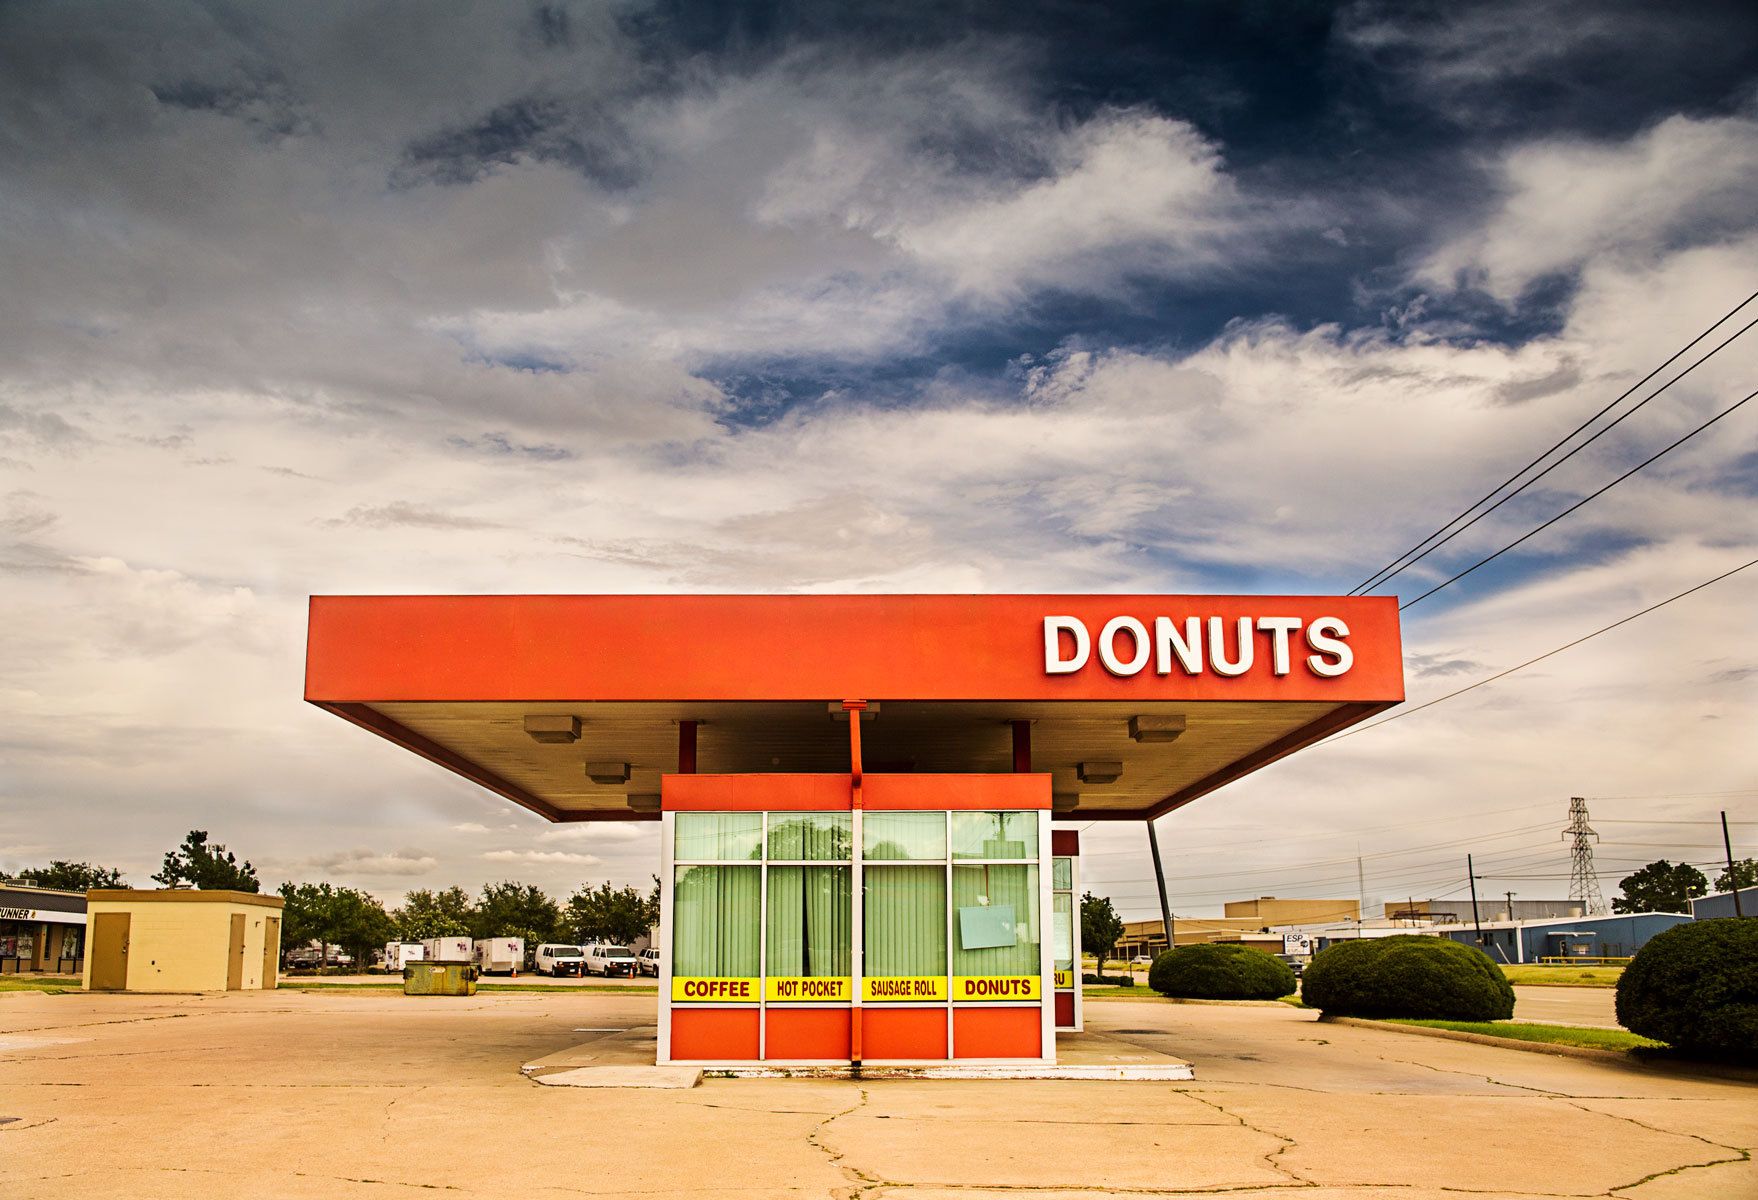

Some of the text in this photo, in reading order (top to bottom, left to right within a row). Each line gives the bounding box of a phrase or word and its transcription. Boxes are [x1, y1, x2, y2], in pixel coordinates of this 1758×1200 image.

[1043, 615, 1354, 678] DONUTS
[0, 908, 29, 919] UNNER
[1287, 934, 1303, 942] ESP
[684, 980, 750, 997] COFFEE
[777, 981, 843, 997] HOT POCKET
[871, 980, 937, 996] SAUSAGE ROLL
[965, 979, 1031, 995] DONUTS
